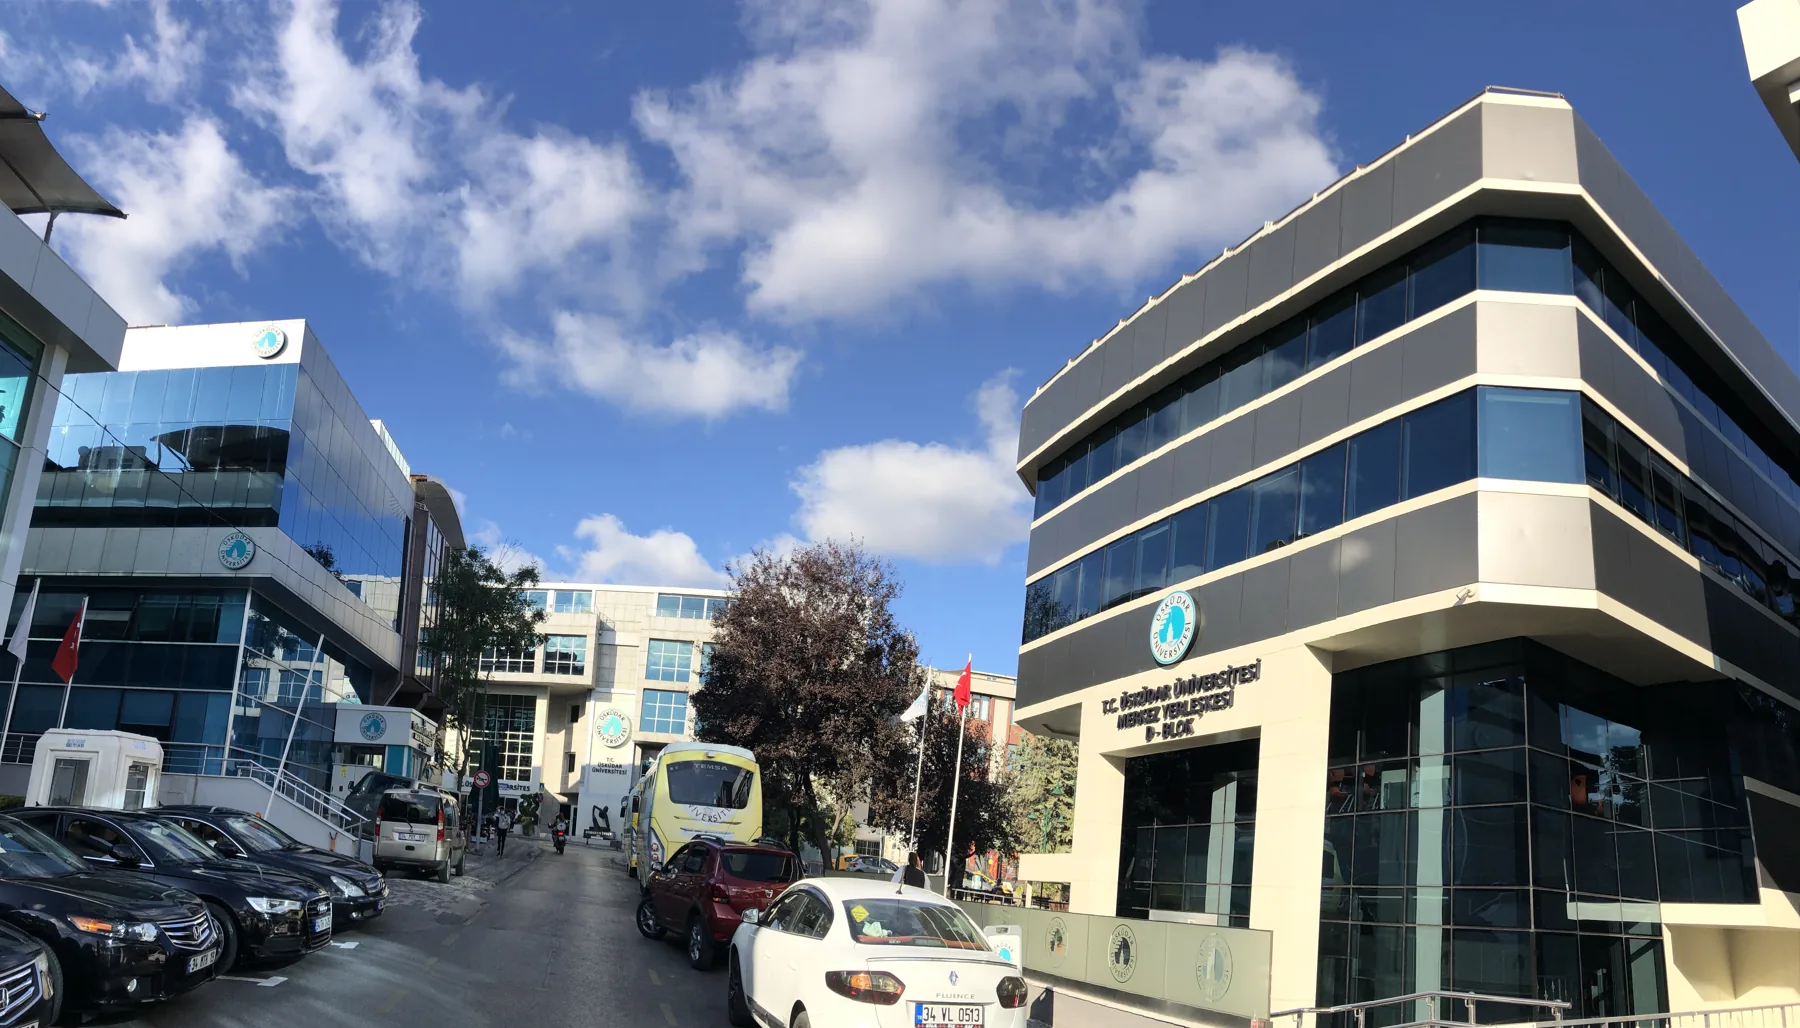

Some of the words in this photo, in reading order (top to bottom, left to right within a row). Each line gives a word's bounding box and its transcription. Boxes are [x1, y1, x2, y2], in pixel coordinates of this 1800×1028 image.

[1119, 686, 1172, 712] ÜSKÜDAR
[1173, 657, 1262, 698] ÜNİVERSİTESİ
[1116, 705, 1162, 731] MERKEZ
[1162, 688, 1235, 720] YERLEŞKESİ
[694, 763, 728, 771] TEMSA
[923, 1007, 936, 1021] 34
[941, 1007, 954, 1022] VL
[958, 1008, 980, 1023] 0513
